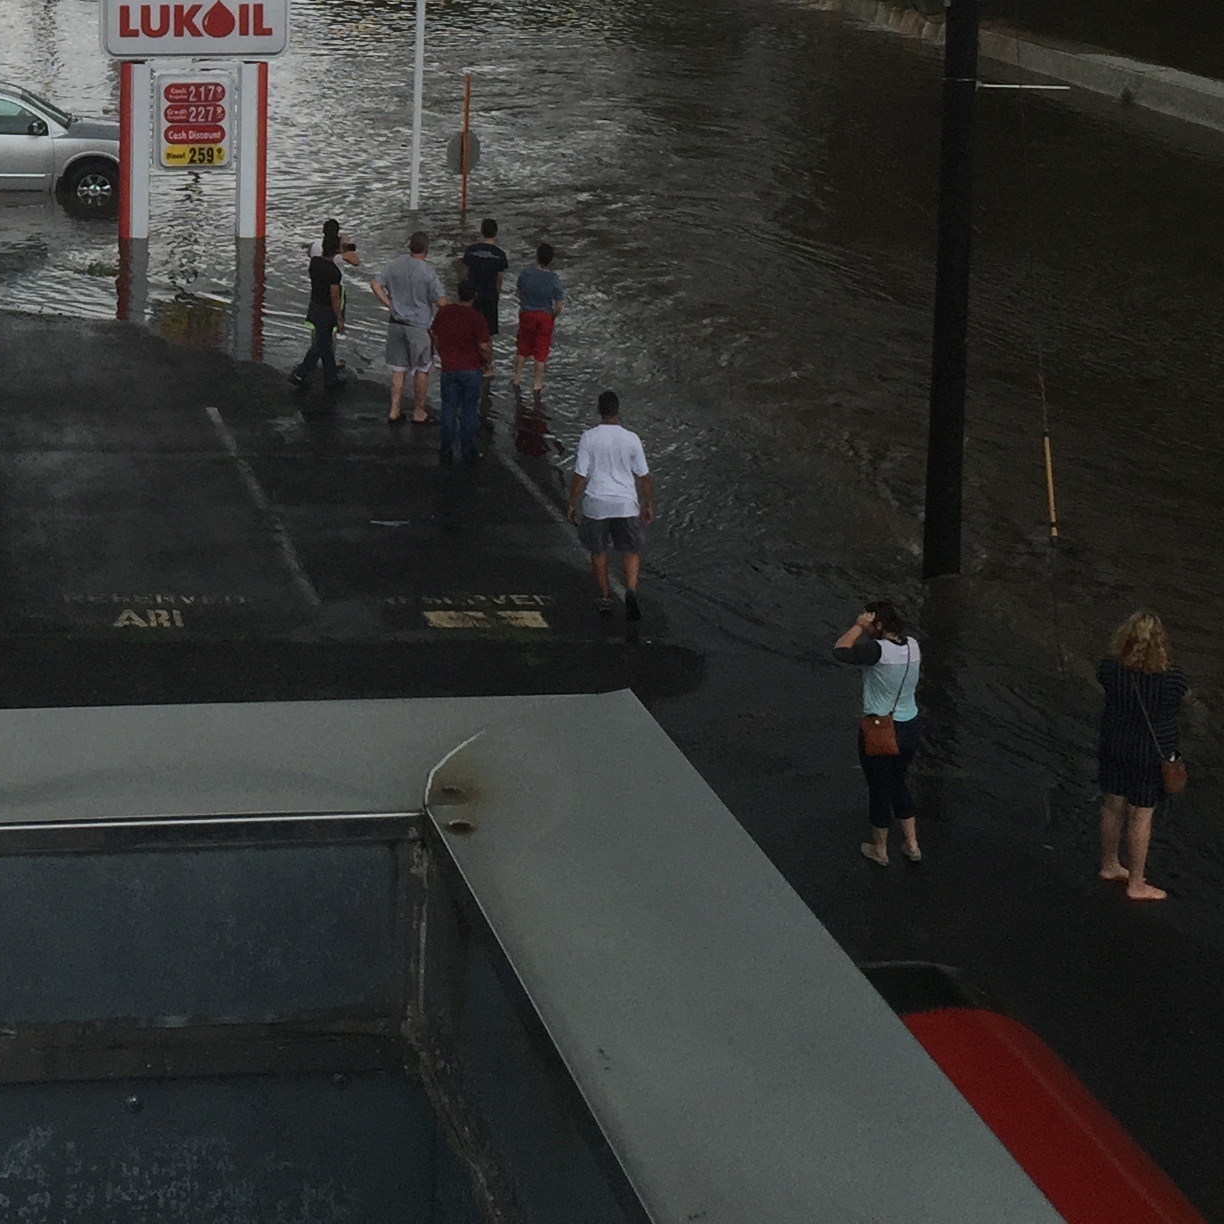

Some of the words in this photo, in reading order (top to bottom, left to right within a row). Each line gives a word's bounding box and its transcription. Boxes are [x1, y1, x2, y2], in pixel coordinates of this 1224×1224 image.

[119, 0, 273, 38] LUKOIL
[189, 85, 215, 102] 217
[188, 106, 214, 122] 227
[168, 131, 187, 140] Cash
[188, 130, 221, 140] Discount
[188, 147, 214, 164] 259
[112, 608, 185, 628] ARI
